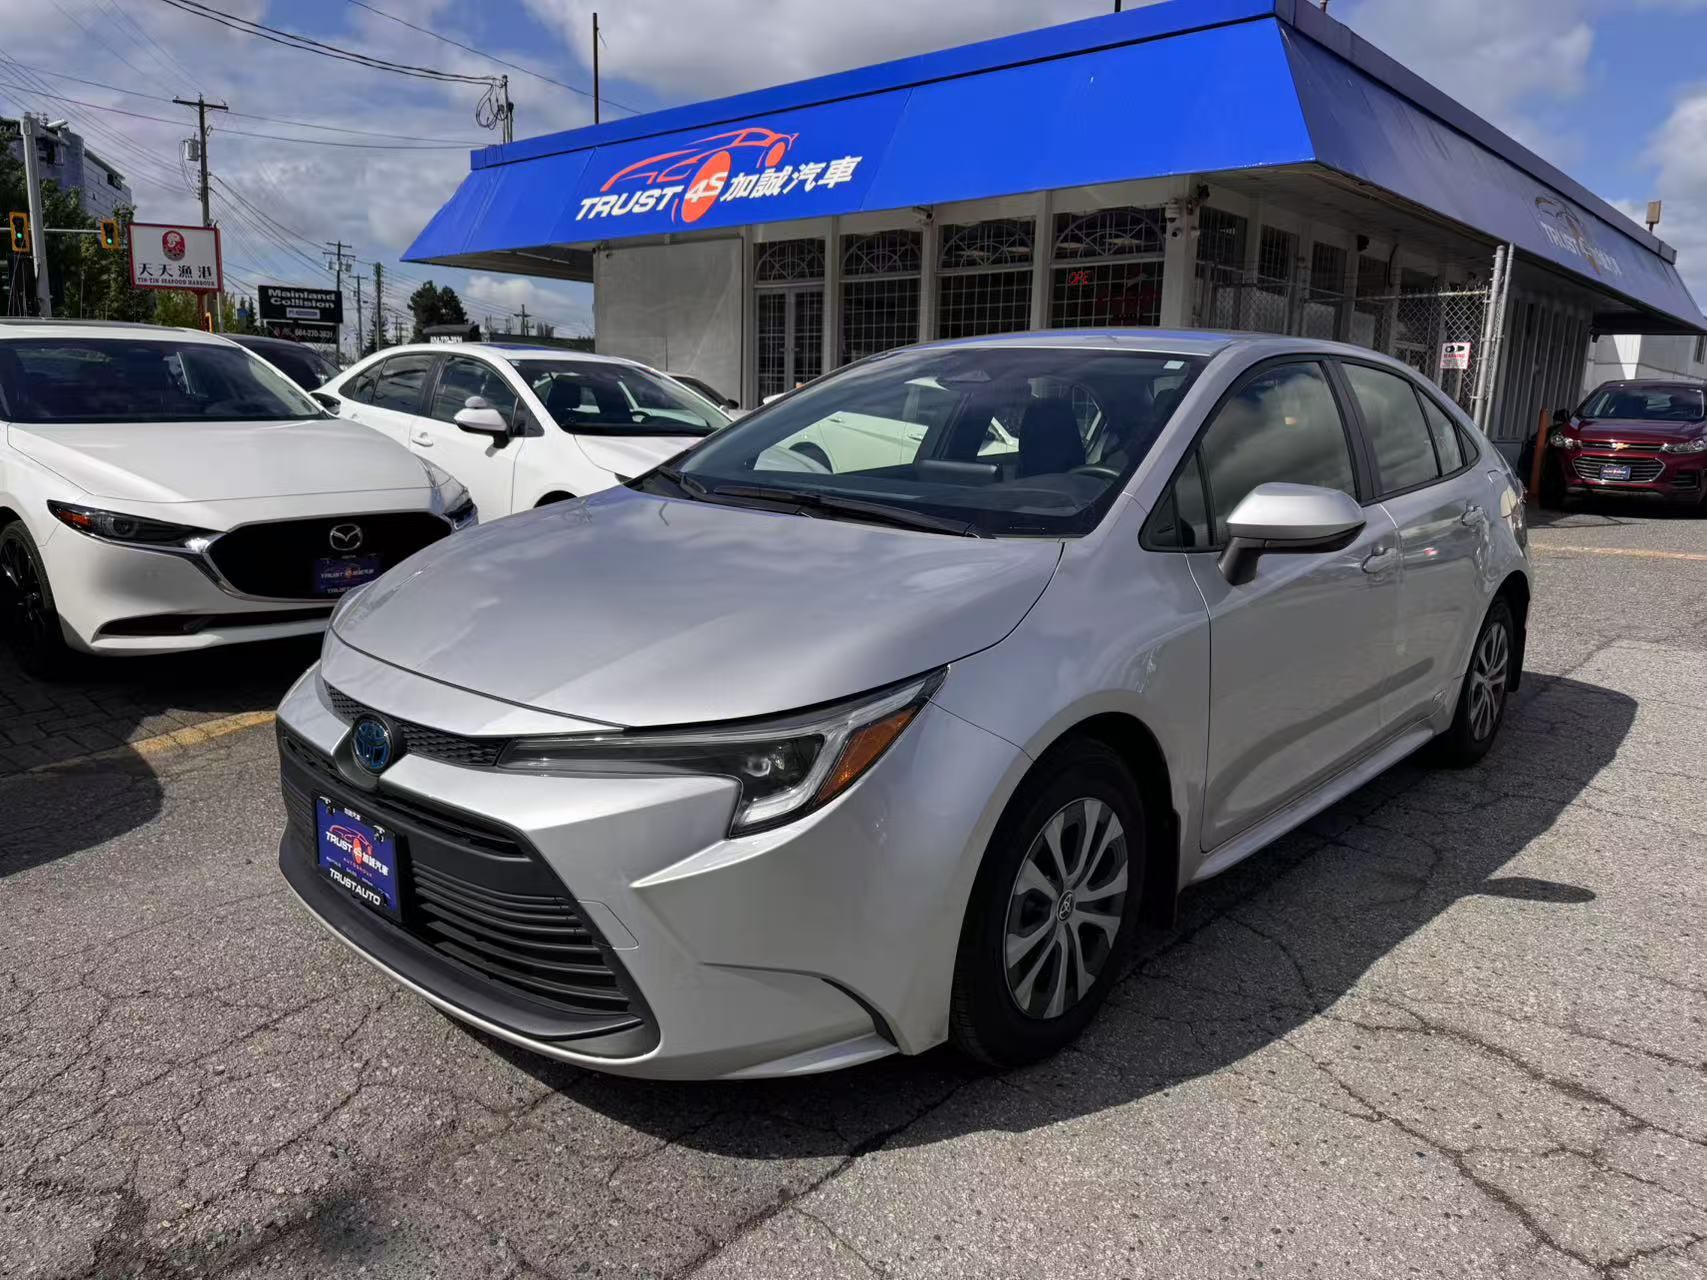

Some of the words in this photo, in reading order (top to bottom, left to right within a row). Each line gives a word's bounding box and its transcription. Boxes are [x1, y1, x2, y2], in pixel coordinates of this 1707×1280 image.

[720, 155, 863, 202] 加誠汽車
[575, 185, 685, 221] TRUST
[686, 171, 728, 203] 4S
[138, 263, 212, 279] 天天漁港
[268, 288, 336, 300] Mainland
[270, 297, 335, 308] Collision
[326, 831, 353, 853] TRUST
[329, 868, 381, 906] TRUSTAUTO
